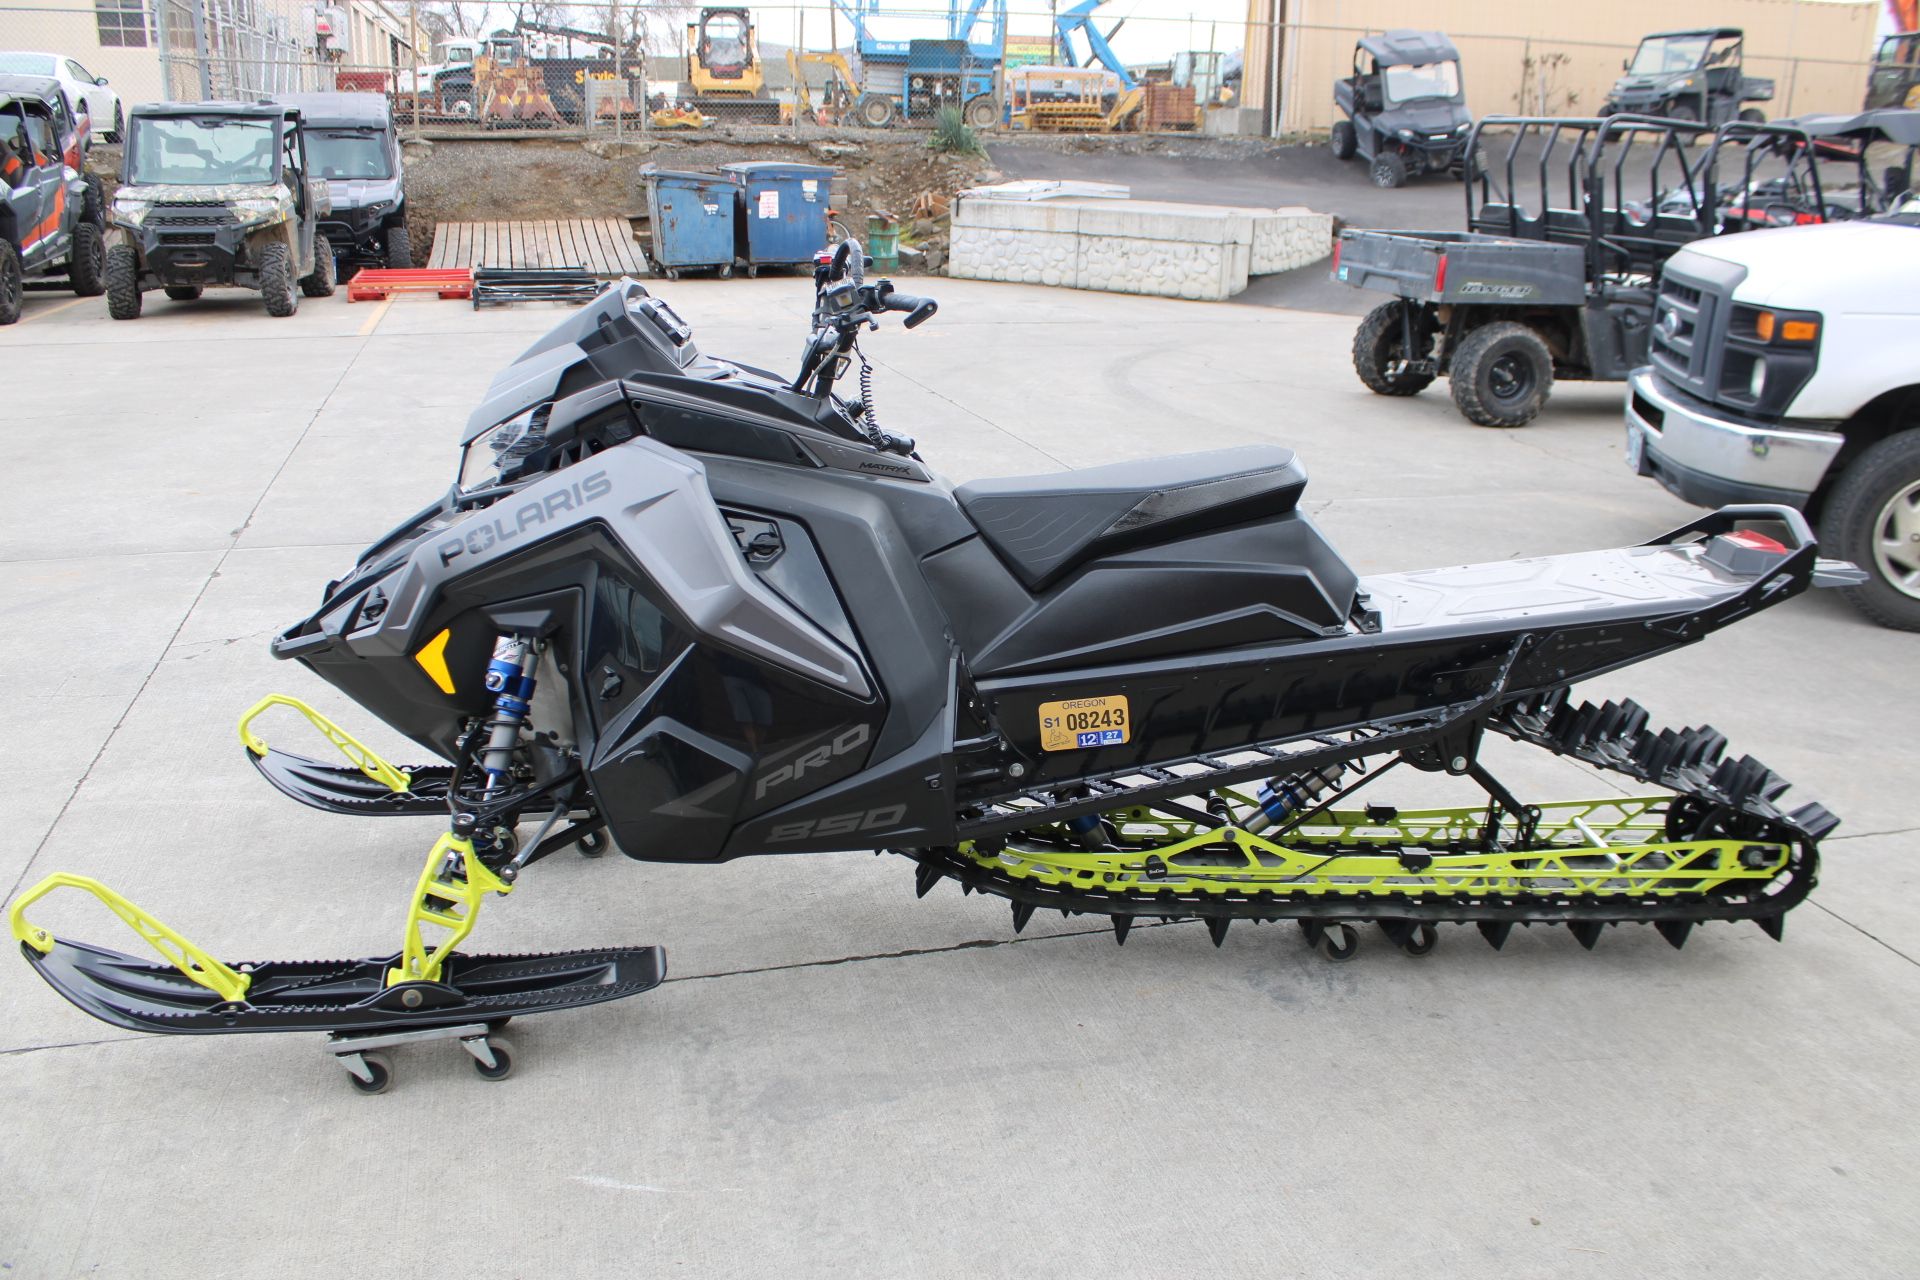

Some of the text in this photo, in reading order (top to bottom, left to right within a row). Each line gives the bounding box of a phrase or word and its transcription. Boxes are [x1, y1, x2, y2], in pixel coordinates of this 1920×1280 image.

[858, 462, 911, 475] MATRYX
[437, 470, 612, 568] POLARIS
[1062, 699, 1106, 710] OREGON
[1044, 708, 1125, 731] S1 08243
[1080, 733, 1097, 746] 12
[1106, 731, 1119, 739] 27
[755, 723, 870, 801] PRO
[765, 803, 907, 843] 850
